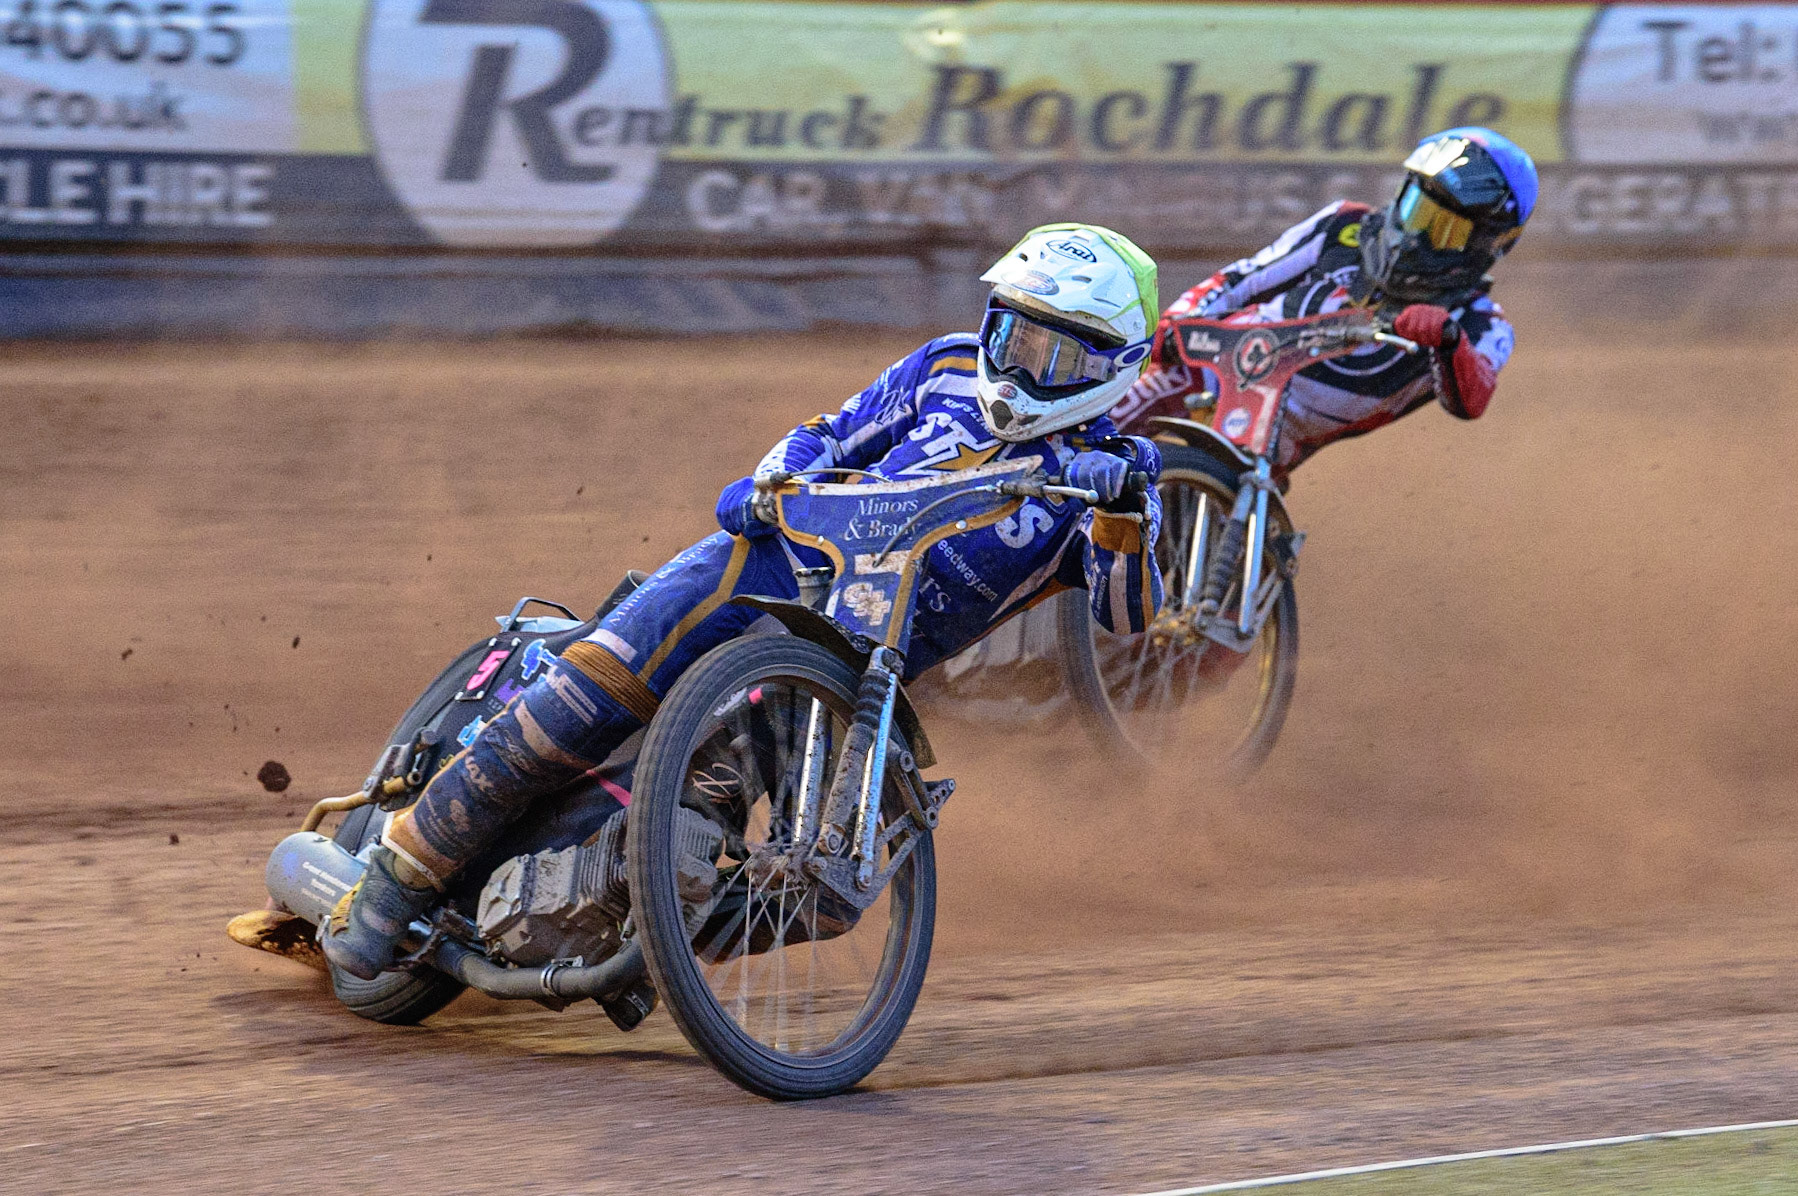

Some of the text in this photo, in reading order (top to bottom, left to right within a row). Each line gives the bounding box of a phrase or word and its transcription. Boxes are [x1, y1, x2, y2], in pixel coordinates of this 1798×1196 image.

[908, 61, 1506, 156] Rochdale
[106, 160, 276, 227] HIRE
[844, 517, 866, 541] &
[855, 496, 919, 517] Minors
[937, 539, 998, 602] eedway.com
[466, 650, 511, 691] 5
